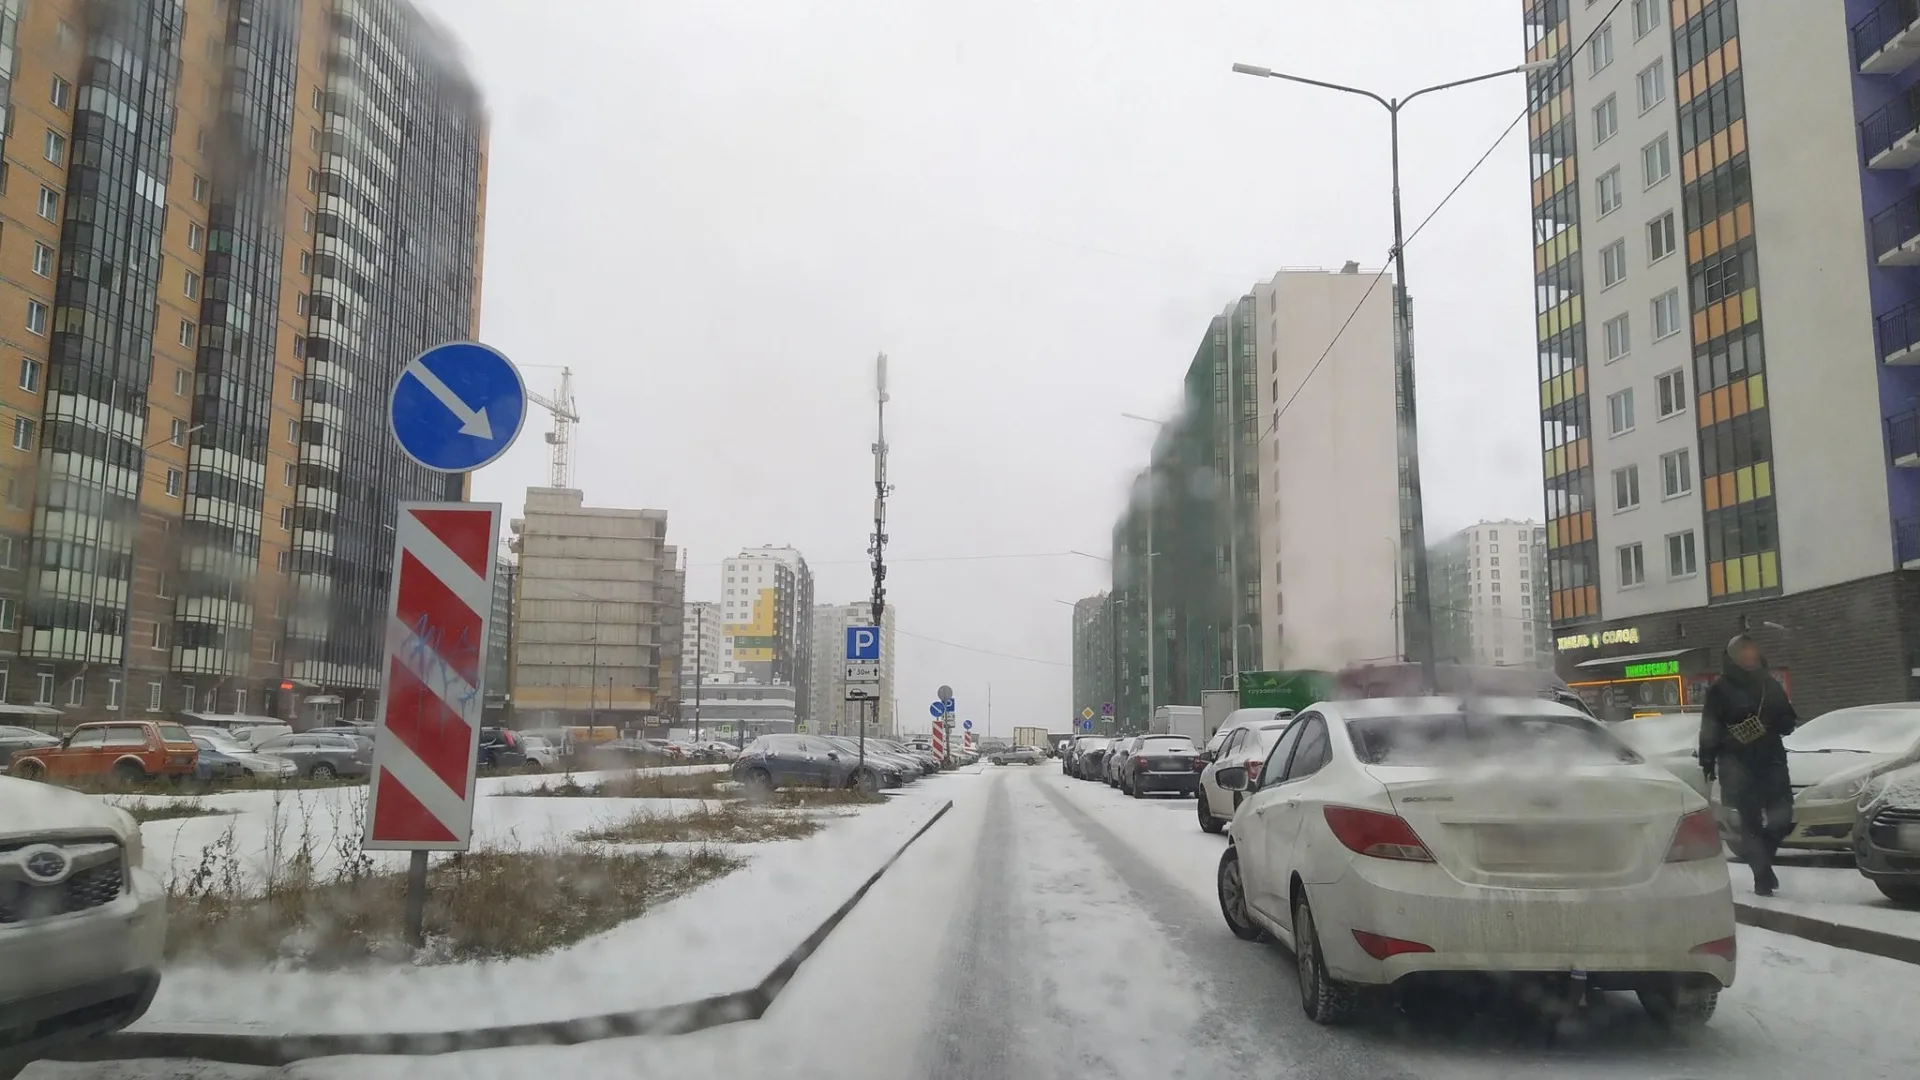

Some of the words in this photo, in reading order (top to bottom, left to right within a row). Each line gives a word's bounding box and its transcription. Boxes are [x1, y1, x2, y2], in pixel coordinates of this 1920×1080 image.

[855, 630, 874, 657] P
[1557, 634, 1589, 650] ХМЕЛЬ
[1602, 627, 1639, 644] СОЛОД
